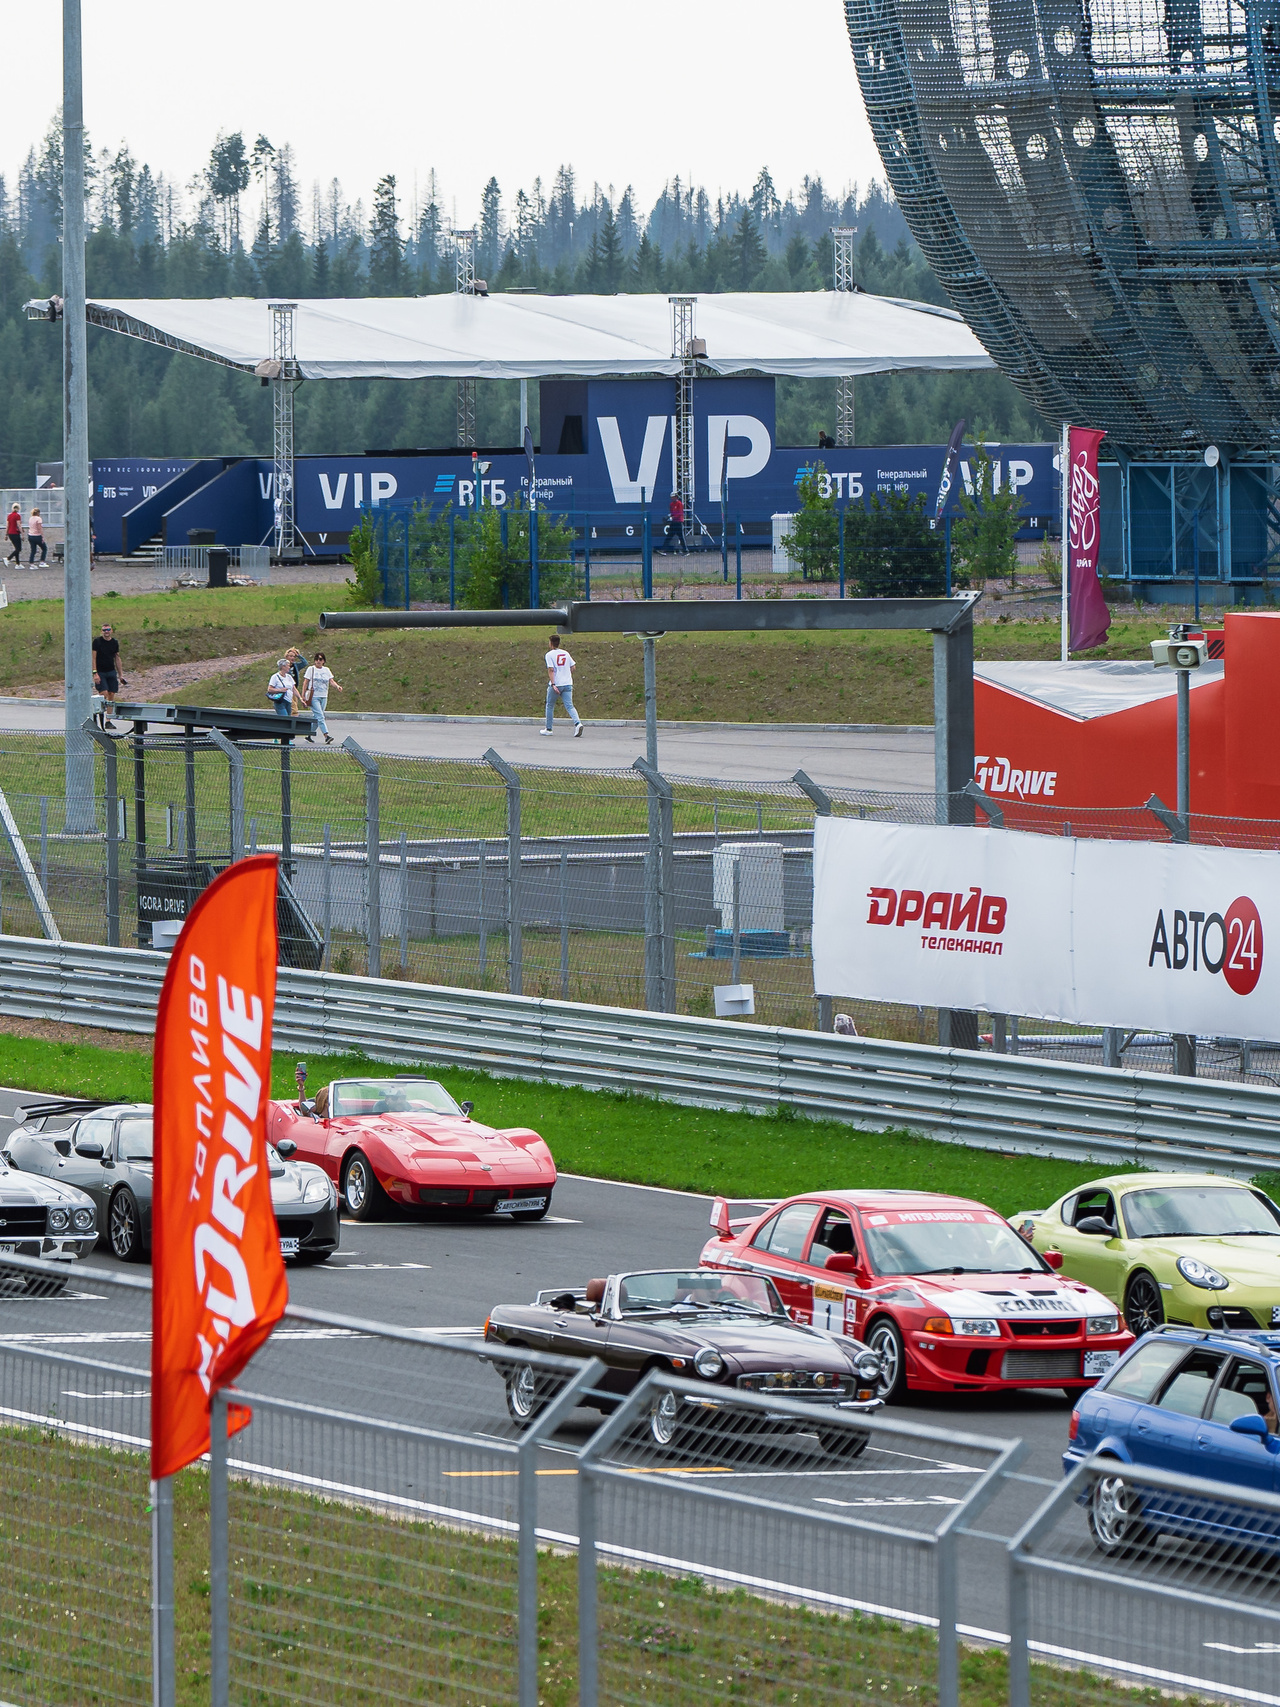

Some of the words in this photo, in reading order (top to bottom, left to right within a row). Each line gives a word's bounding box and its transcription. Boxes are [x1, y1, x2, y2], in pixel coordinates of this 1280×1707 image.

[520, 475, 573, 487] Гееральный
[817, 472, 864, 499] ВТБ
[877, 468, 928, 480] Генеральный
[960, 460, 1034, 495] VIP
[103, 486, 117, 498] ВТБ
[142, 485, 158, 498] VIP
[258, 472, 292, 500] VIP
[318, 472, 398, 509] VIP
[458, 479, 507, 507] ВТБ
[556, 653, 567, 667] G
[139, 895, 163, 911] IGORA
[164, 897, 185, 914] DRIVE
[865, 886, 1008, 935] ДРАЙВ
[188, 953, 213, 1203] ТОПЛИВО
[897, 1212, 975, 1223] MITSUBISHI
